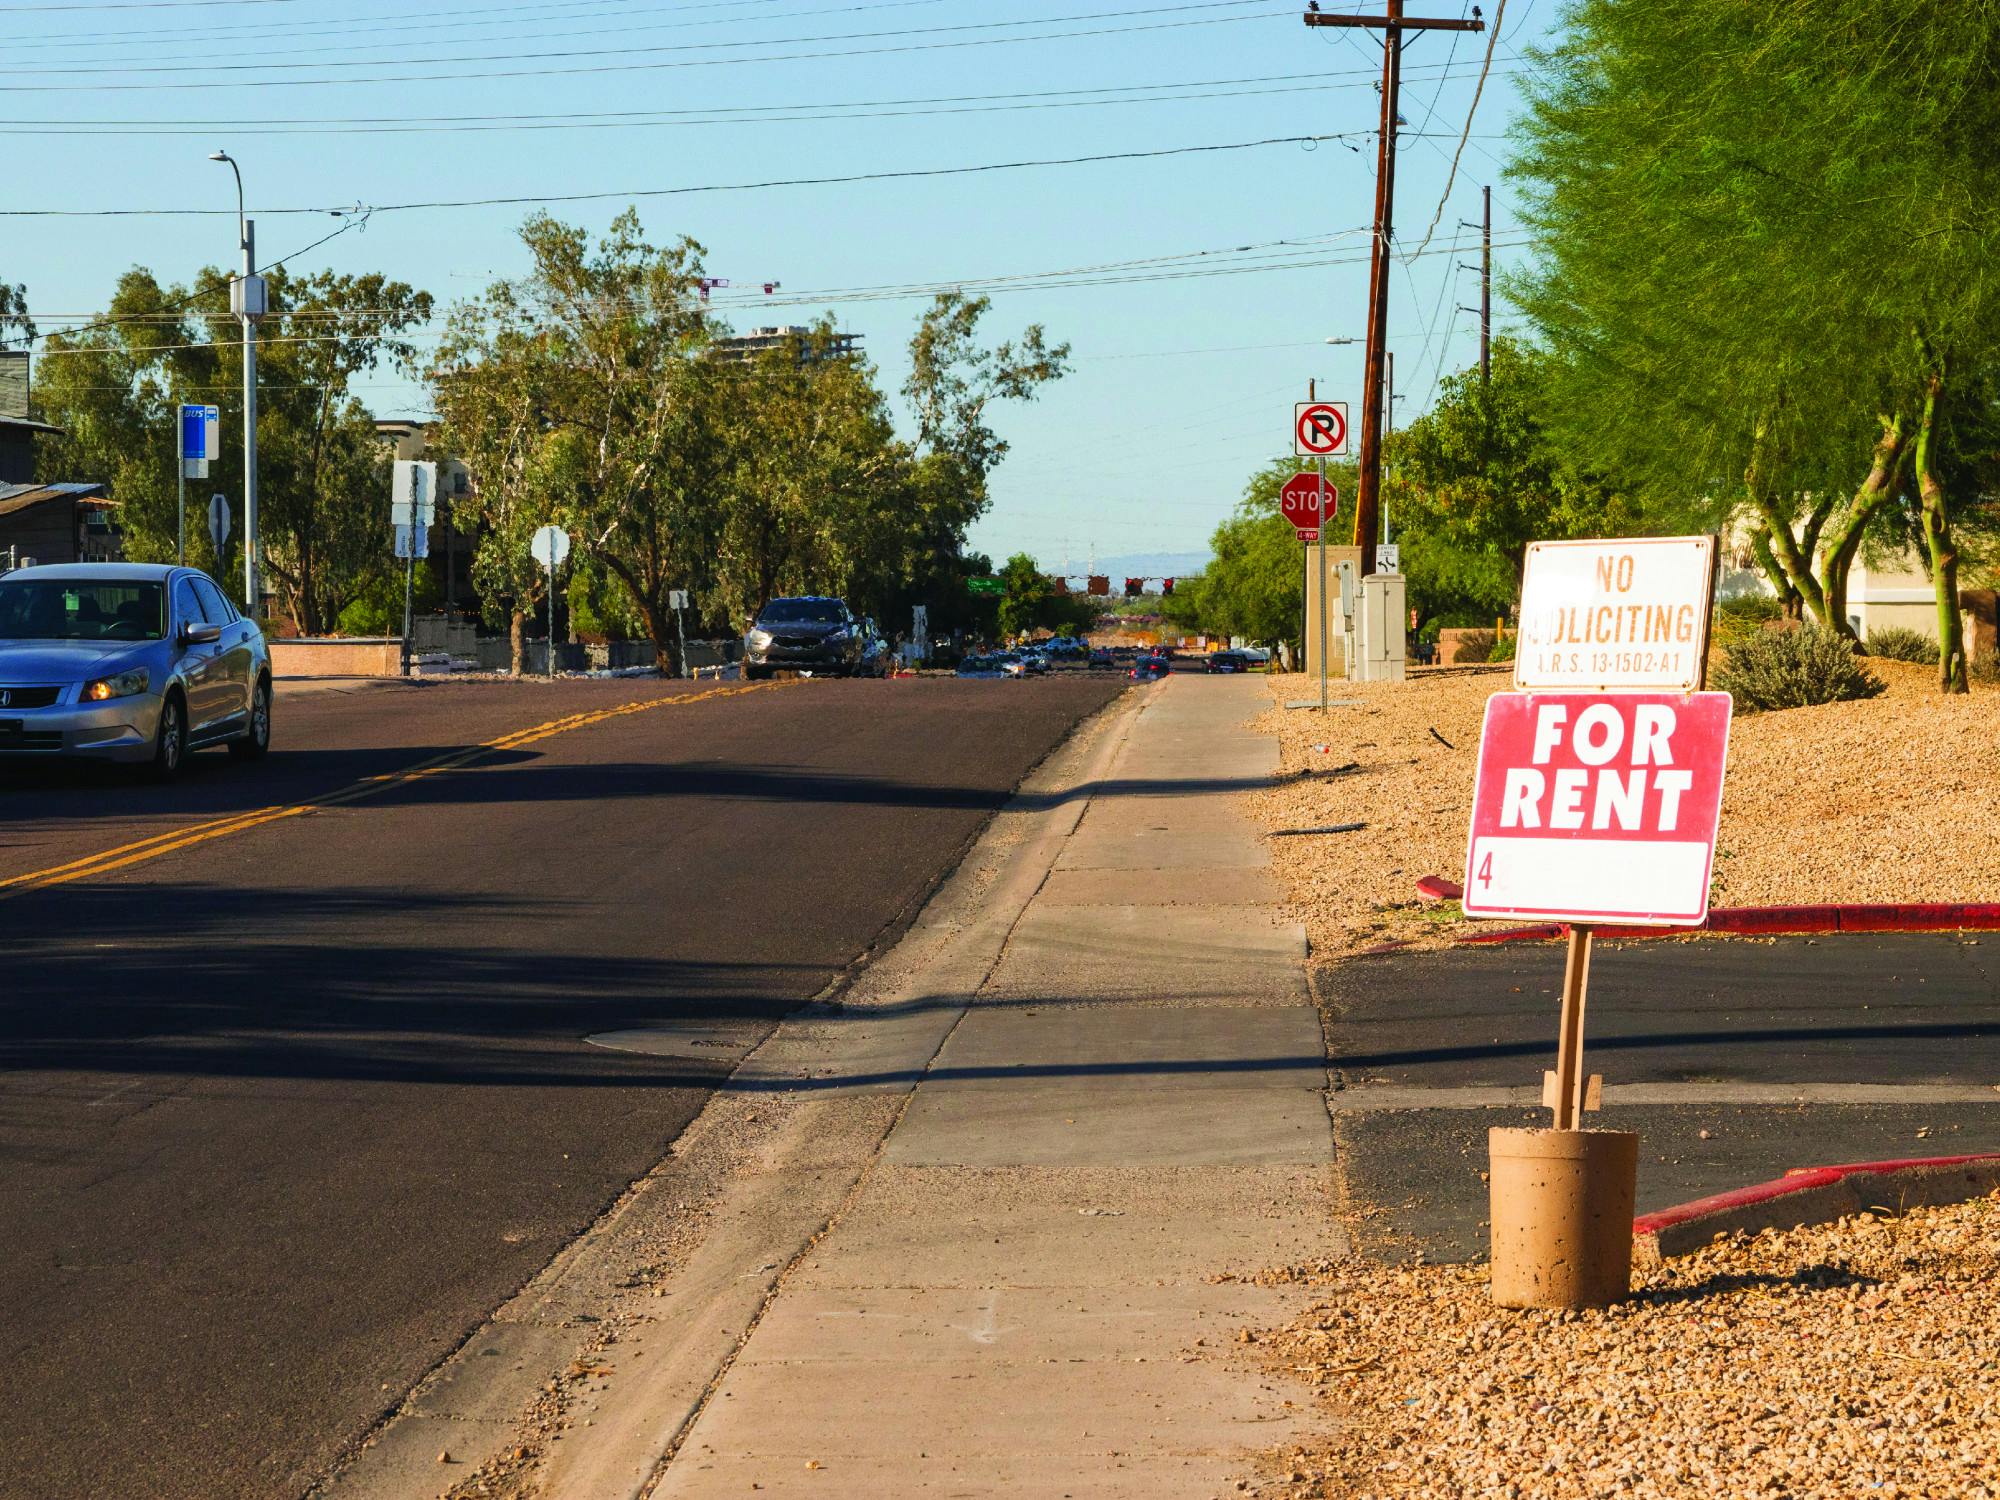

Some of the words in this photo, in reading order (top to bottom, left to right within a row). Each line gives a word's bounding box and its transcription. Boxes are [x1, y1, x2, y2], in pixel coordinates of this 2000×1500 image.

[184, 410, 204, 418] BUS
[1285, 490, 1333, 511] STOP
[1597, 555, 1634, 593] NO
[1528, 603, 1695, 645] OLICITING
[1532, 703, 1677, 766] FOR
[1500, 768, 1693, 831] RENT
[1477, 851, 1493, 890] 4
